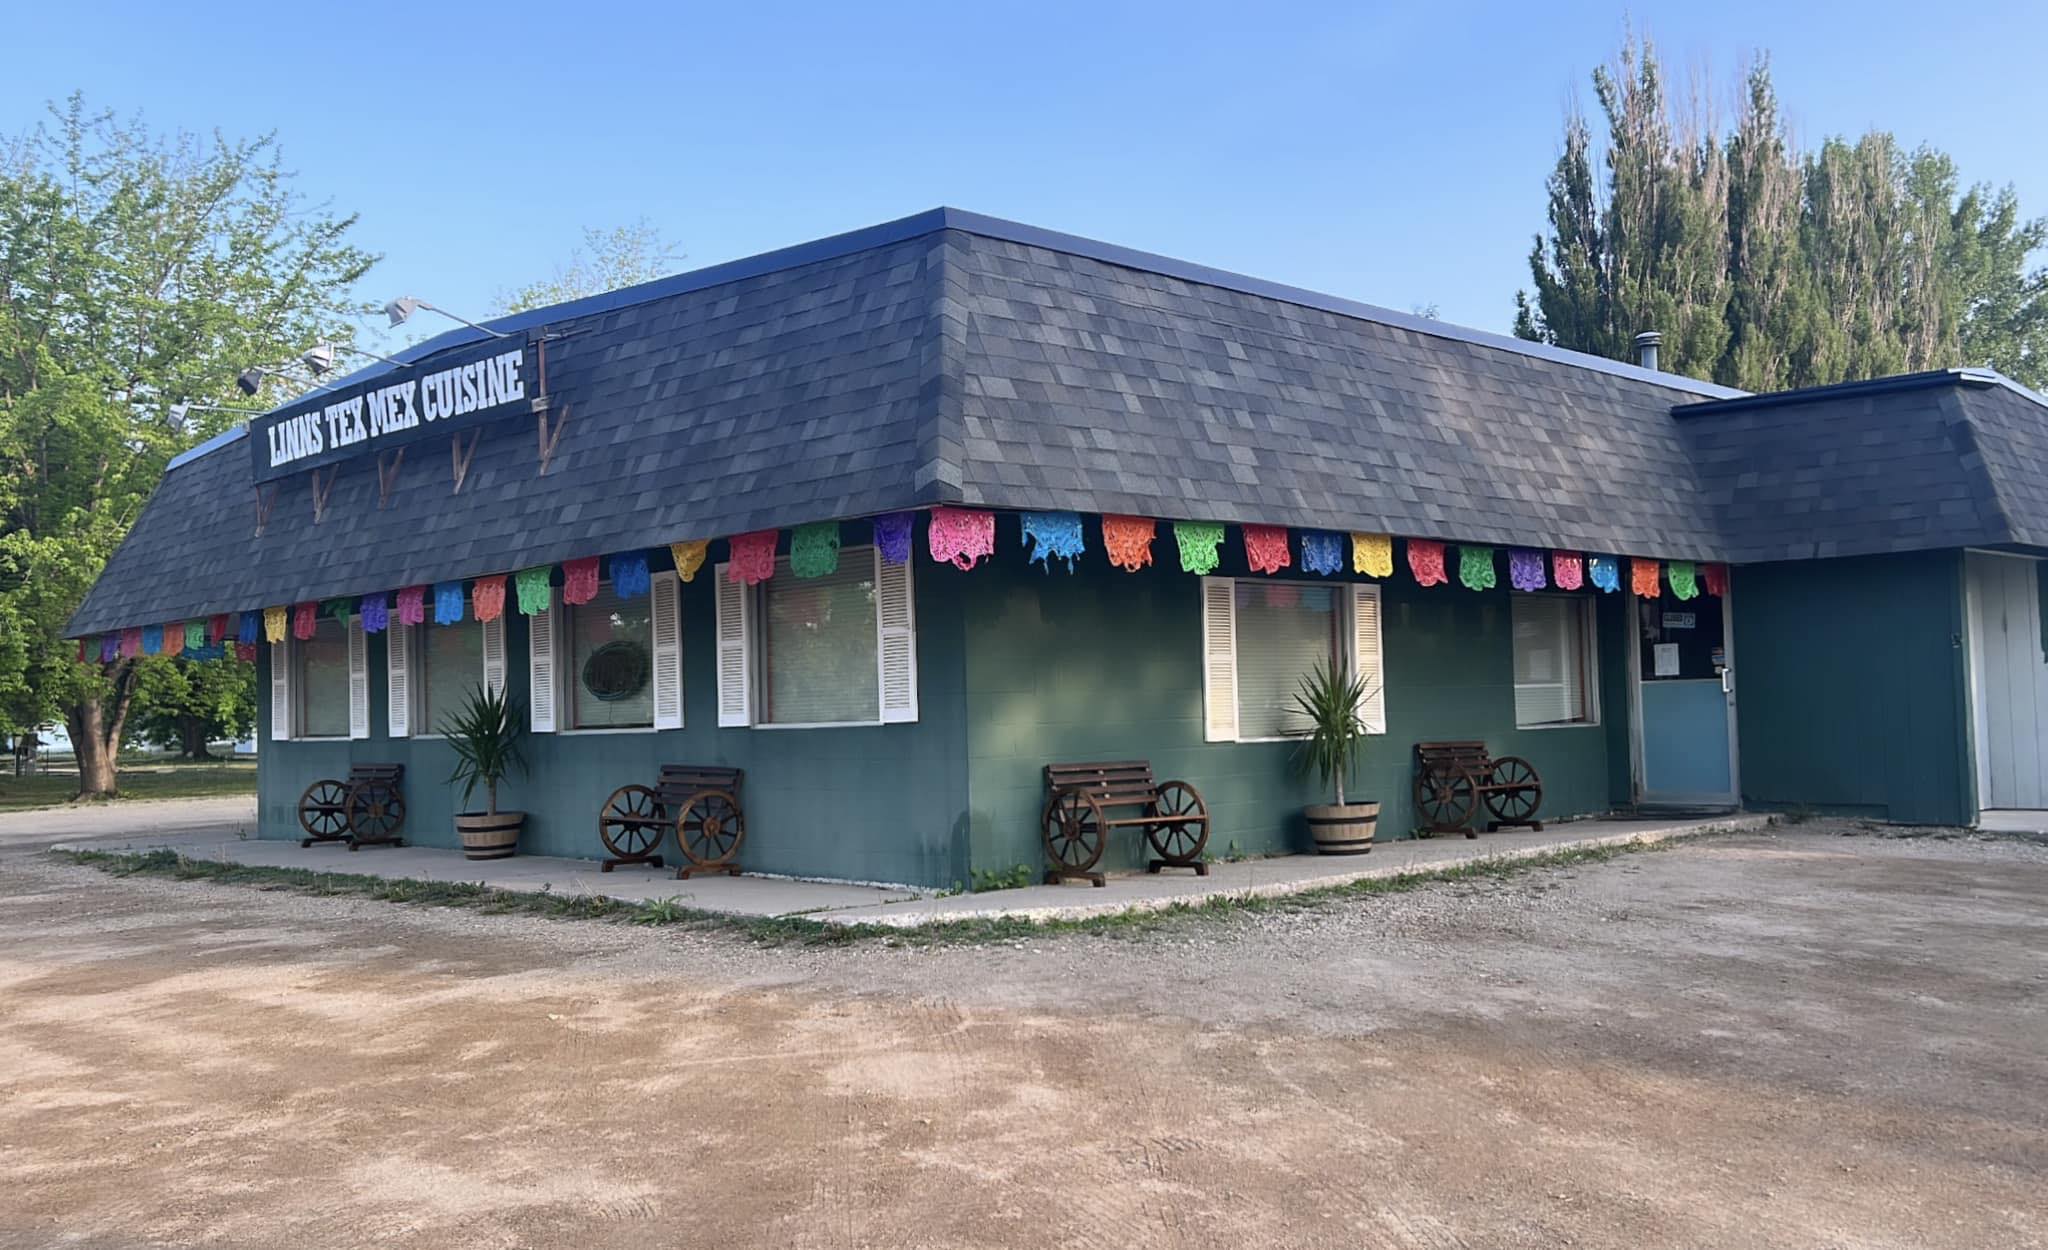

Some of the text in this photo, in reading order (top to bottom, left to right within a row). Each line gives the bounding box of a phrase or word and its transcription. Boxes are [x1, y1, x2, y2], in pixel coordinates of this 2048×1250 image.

[268, 349, 524, 467] LINNS TEX MEX CUISINE
